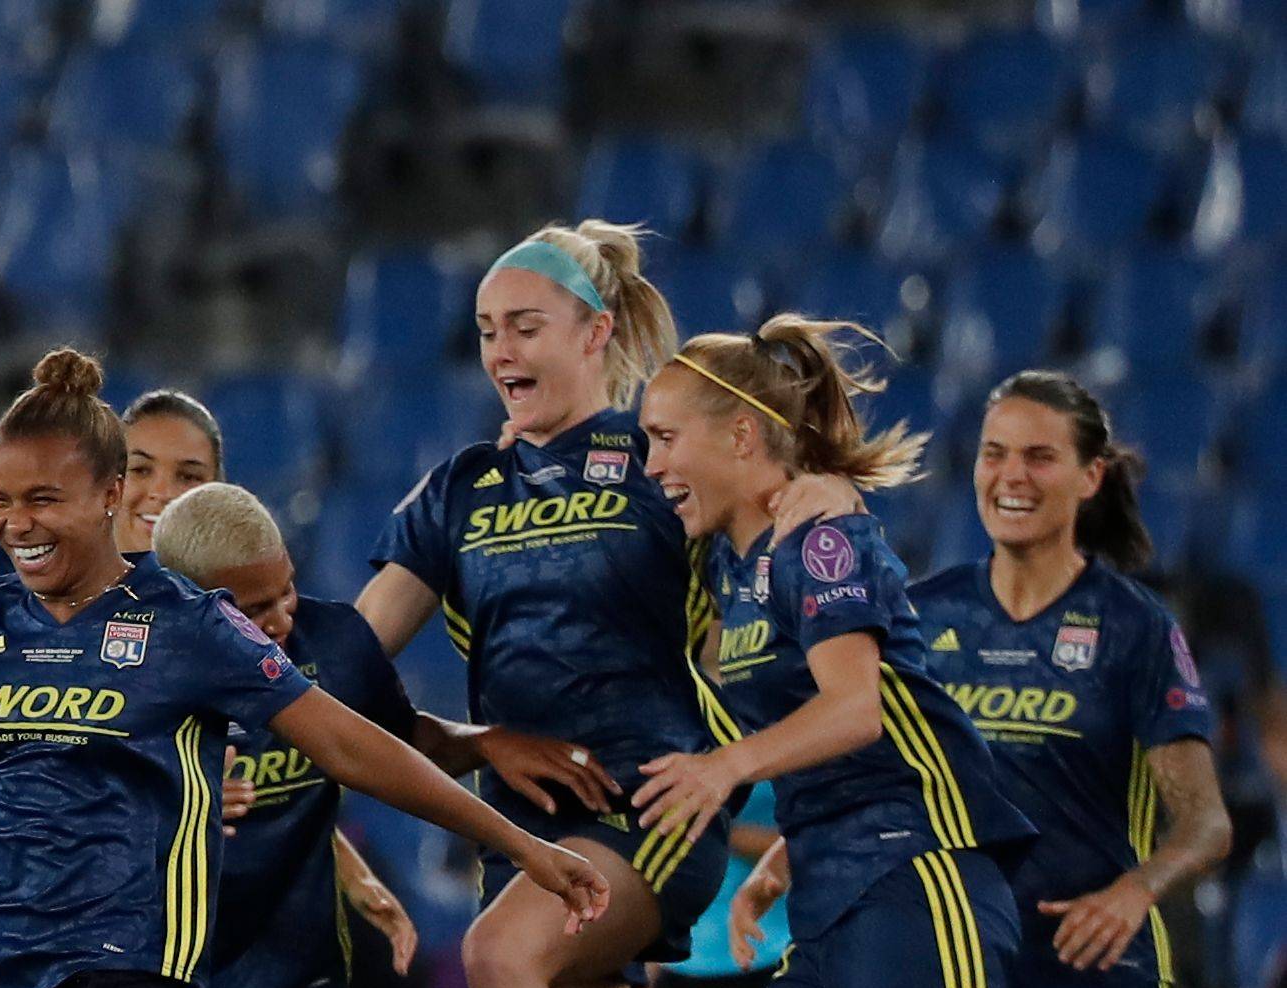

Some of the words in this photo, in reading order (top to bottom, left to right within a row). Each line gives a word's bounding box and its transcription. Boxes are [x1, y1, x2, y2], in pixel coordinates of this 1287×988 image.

[464, 489, 629, 541] SWORD
[945, 682, 1078, 723] WORD
[17, 733, 43, 741] YOUR
[44, 735, 89, 745] BUSINESS
[225, 747, 312, 786] ORD
